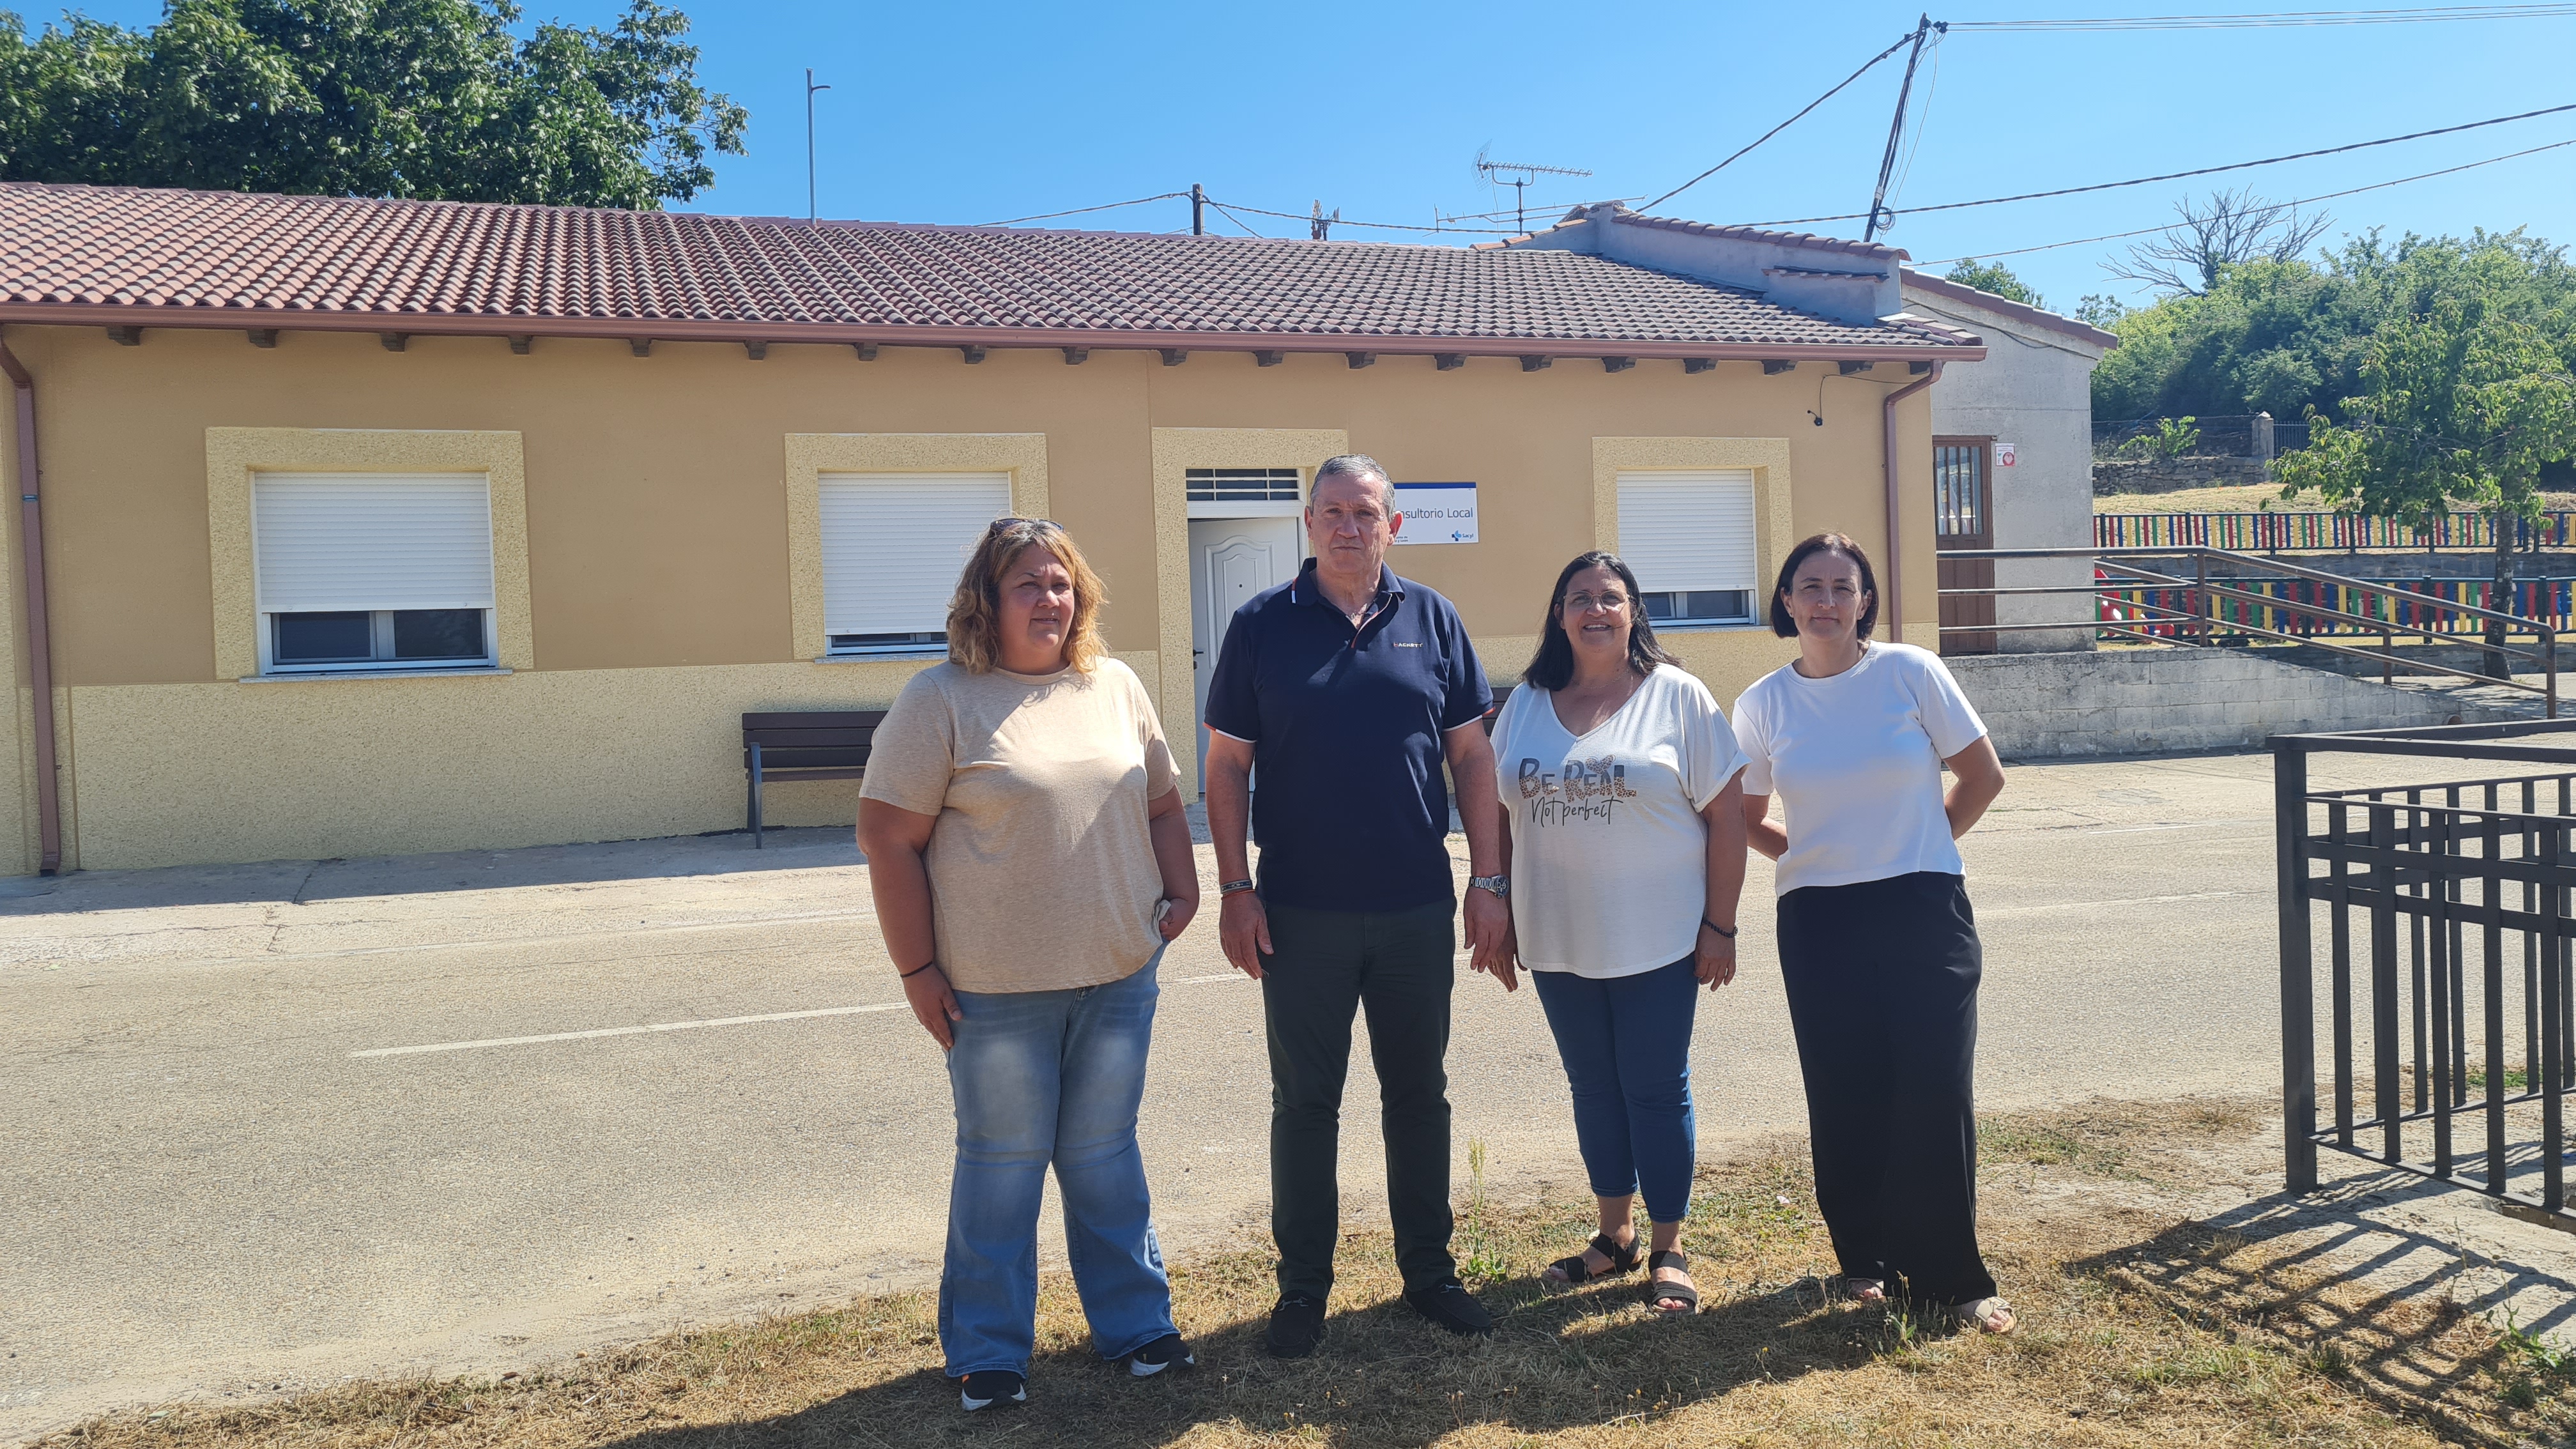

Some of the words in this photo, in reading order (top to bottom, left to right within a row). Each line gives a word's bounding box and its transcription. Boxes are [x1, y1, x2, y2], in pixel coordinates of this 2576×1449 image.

[1401, 508, 1443, 518] nsultorio
[1447, 507, 1473, 518] Local
[1562, 795, 1623, 826] perfect
